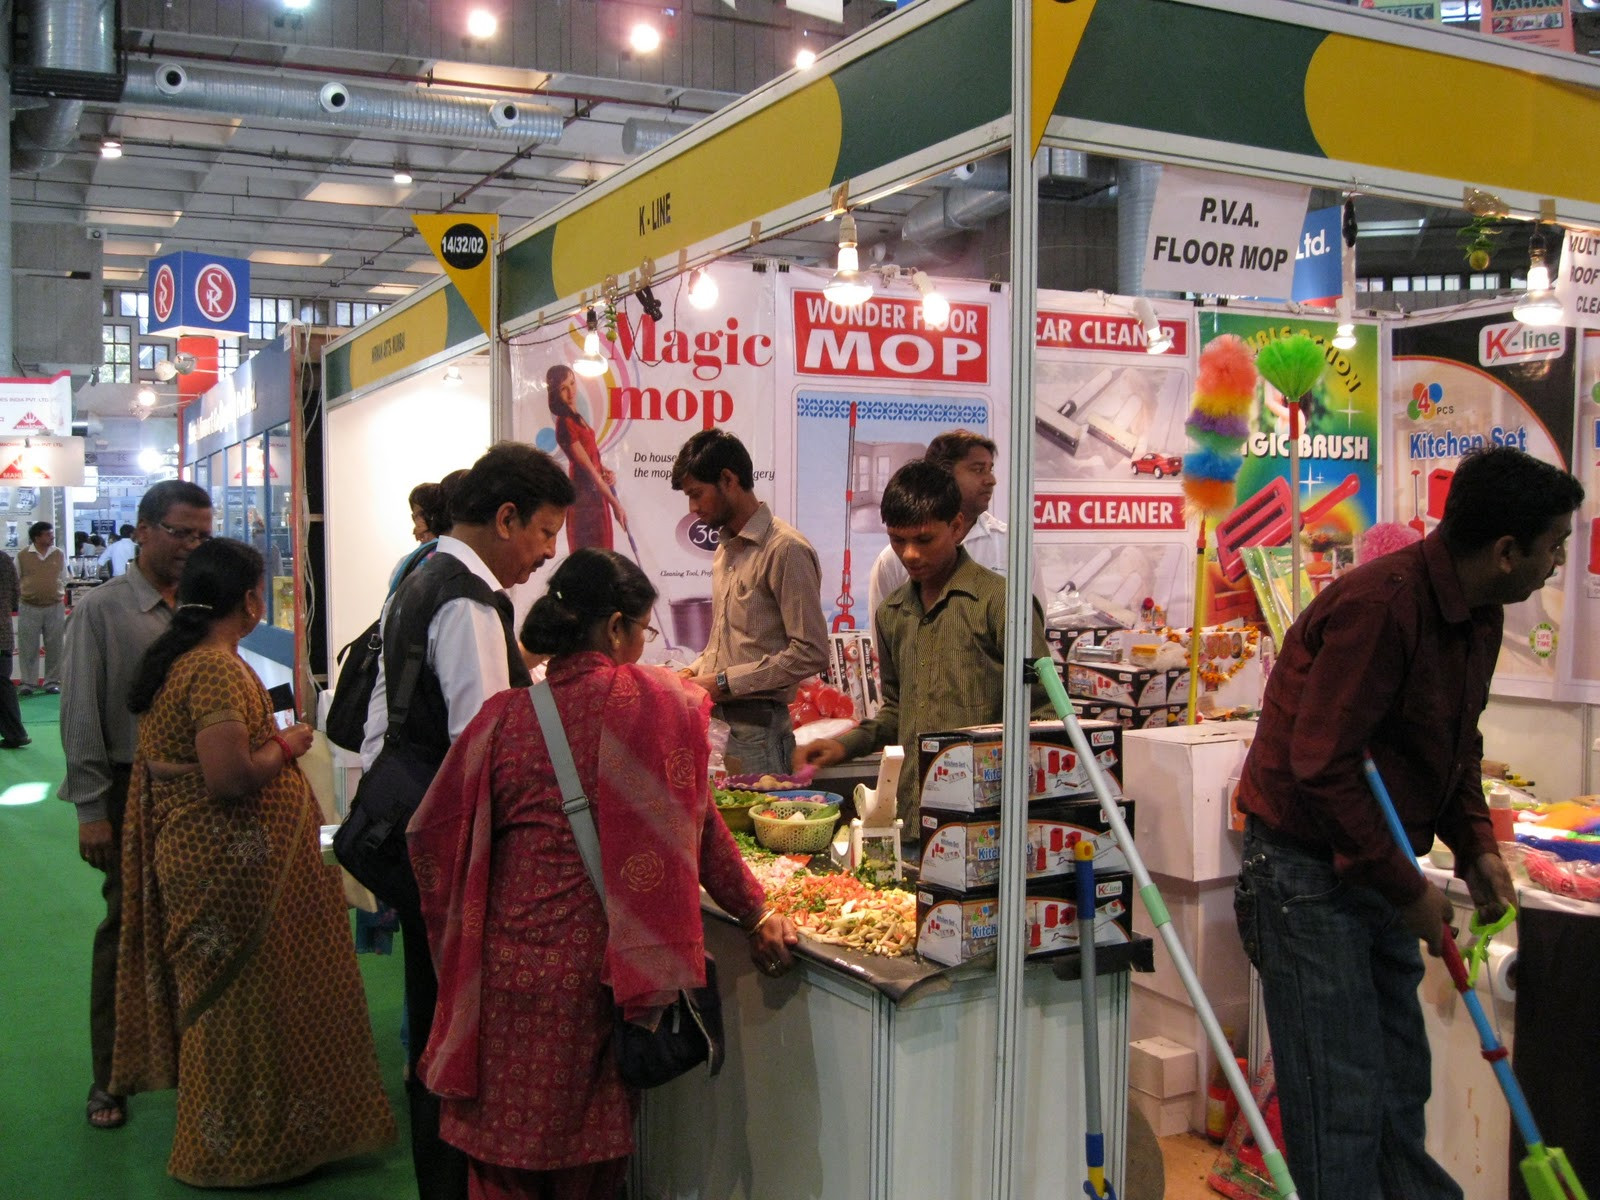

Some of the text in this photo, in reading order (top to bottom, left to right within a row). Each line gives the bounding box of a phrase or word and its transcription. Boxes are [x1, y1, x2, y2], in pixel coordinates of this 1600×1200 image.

[1200, 197, 1259, 228] P.V.A.
[442, 236, 484, 254] 14/32/02
[1153, 236, 1288, 272] FLOOR MOP
[1295, 228, 1331, 260] Ltd.
[806, 298, 978, 334] WONDER FOR
[1576, 295, 1600, 314] CLE
[608, 312, 772, 381] Magic
[1079, 320, 1175, 348] CLEANR
[1486, 328, 1560, 360] K-line
[804, 329, 982, 376] MOP
[607, 387, 734, 430] mop
[1417, 388, 1454, 415] 4 PCS
[634, 452, 647, 462] Do
[1242, 432, 1369, 460] GIC BRUSH
[1410, 426, 1526, 459] Kitchen Set
[634, 468, 649, 478] the
[753, 470, 775, 481] gery
[1079, 501, 1173, 524] CLEANER
